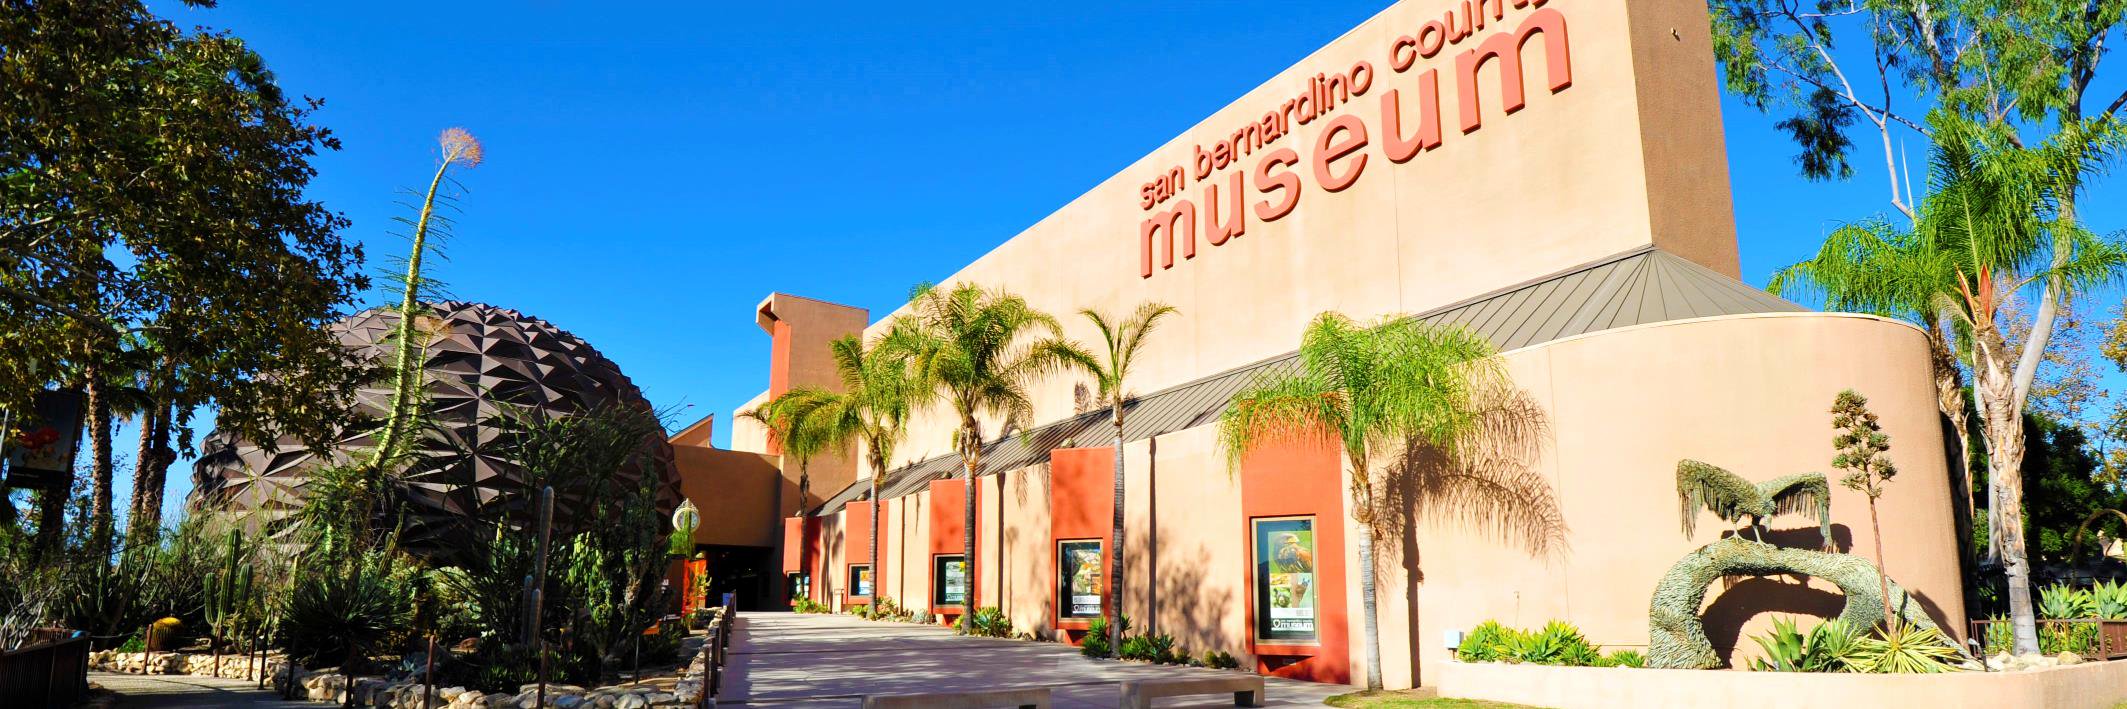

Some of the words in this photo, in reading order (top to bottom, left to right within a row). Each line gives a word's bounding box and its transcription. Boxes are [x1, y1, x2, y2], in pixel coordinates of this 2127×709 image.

[1140, 165, 1185, 210] san
[1194, 61, 1373, 180] bernardino
[1388, 0, 1549, 73] coun
[1140, 7, 1572, 279] museum
